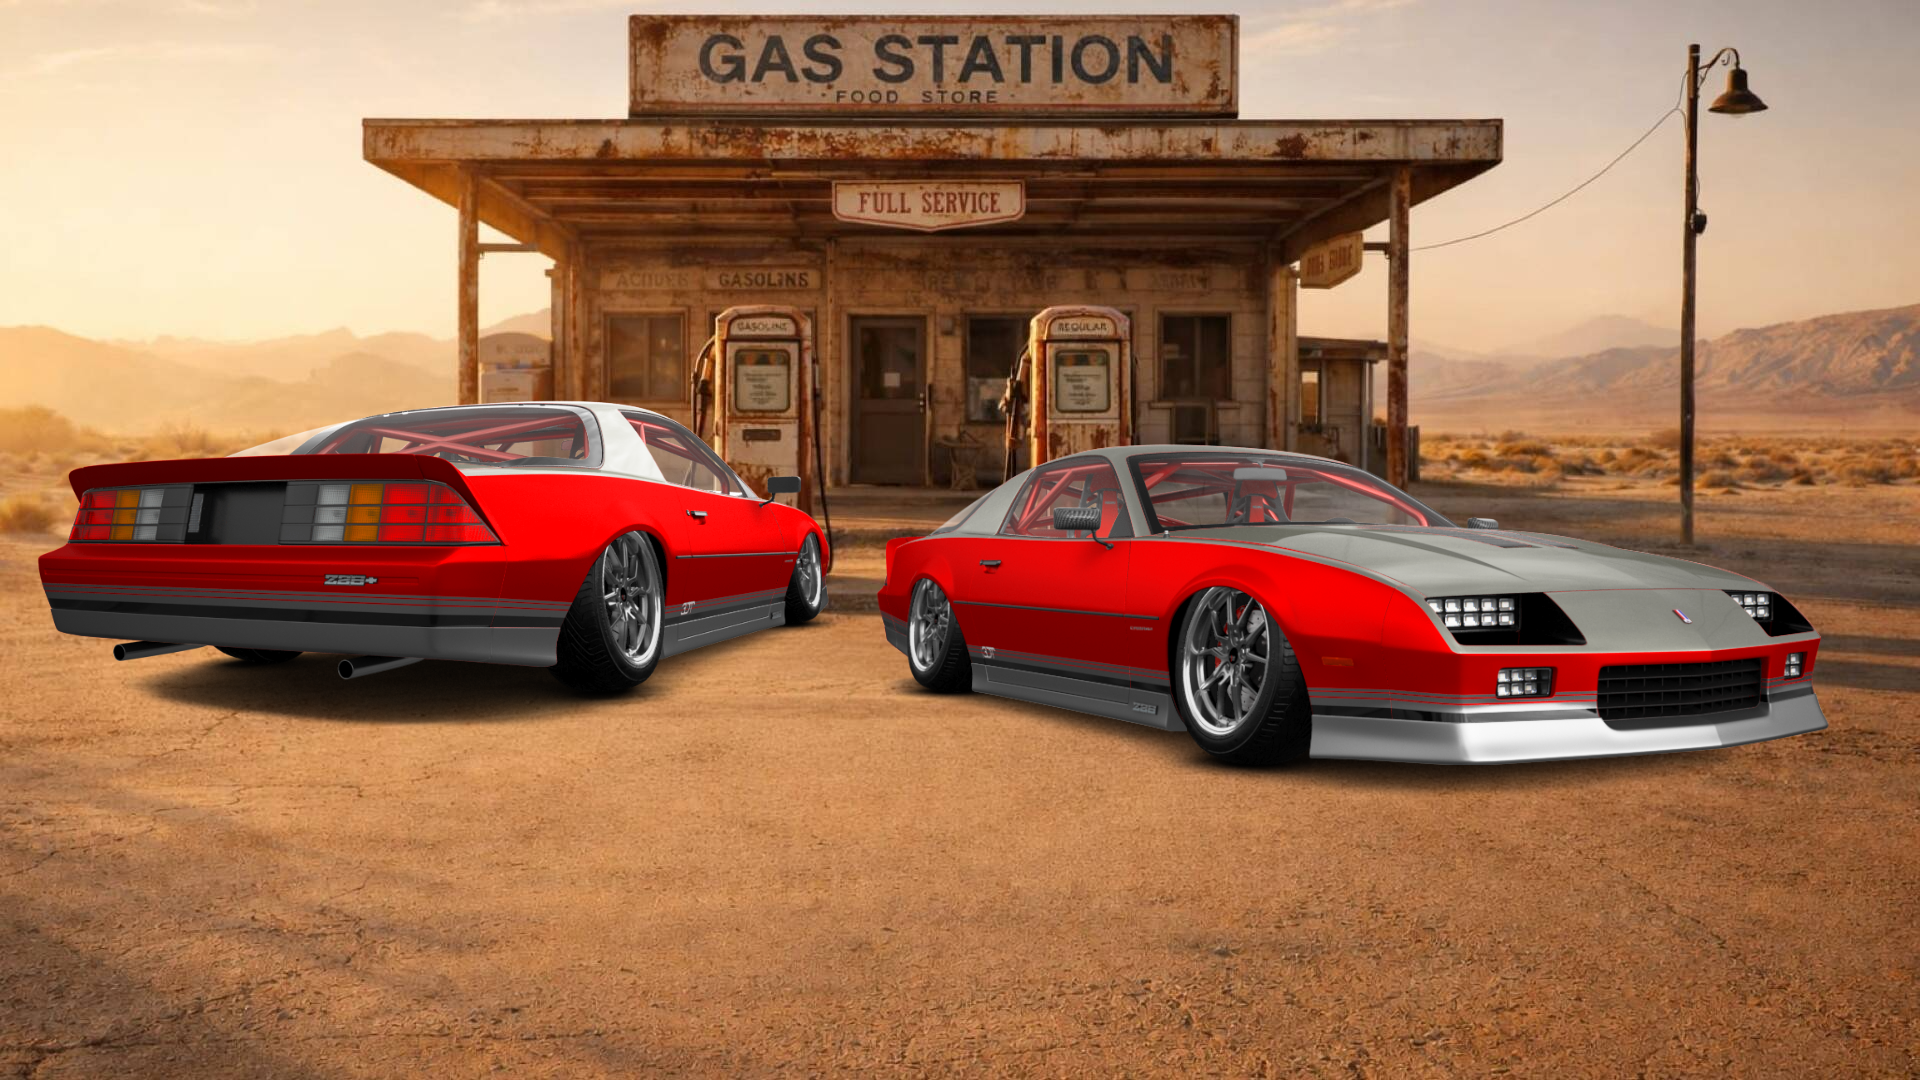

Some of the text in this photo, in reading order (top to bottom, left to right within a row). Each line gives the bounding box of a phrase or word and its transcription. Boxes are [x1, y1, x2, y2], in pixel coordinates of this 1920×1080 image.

[698, 33, 1174, 84] GAS STATION
[836, 90, 999, 103] FOOD STORE
[858, 190, 1002, 214] FULL SERVICE
